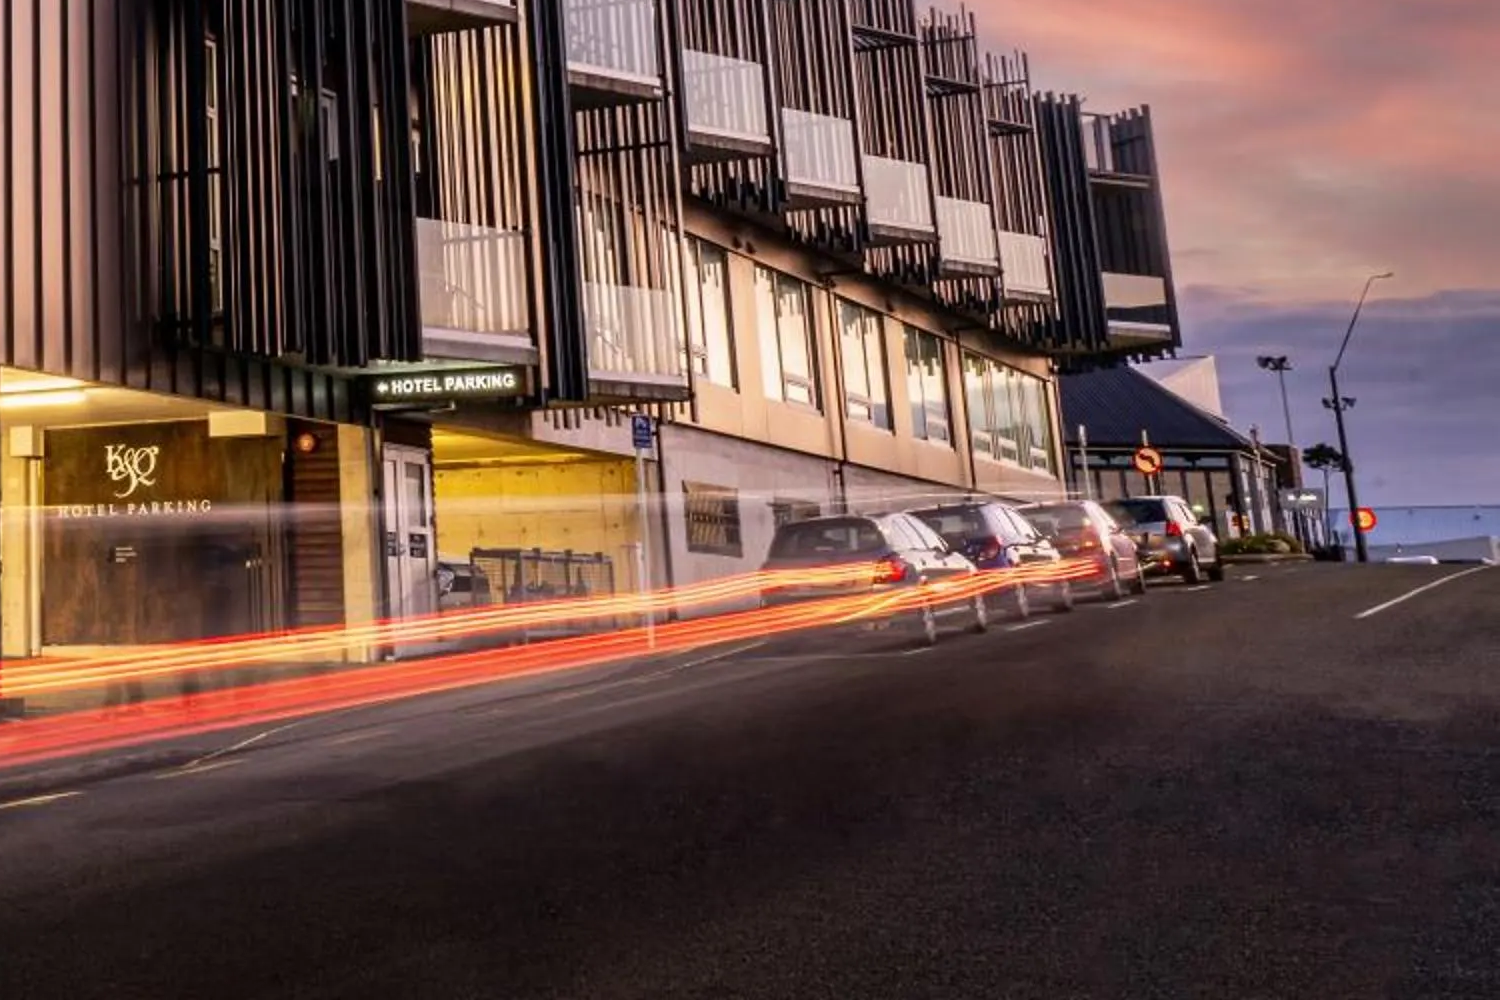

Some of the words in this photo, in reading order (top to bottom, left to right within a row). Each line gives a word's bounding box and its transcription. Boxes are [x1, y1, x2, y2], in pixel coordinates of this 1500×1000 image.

[391, 376, 442, 395] HOTEL
[445, 373, 516, 391] PARKING
[58, 503, 118, 518] HOTEL
[128, 499, 212, 516] PARKING
